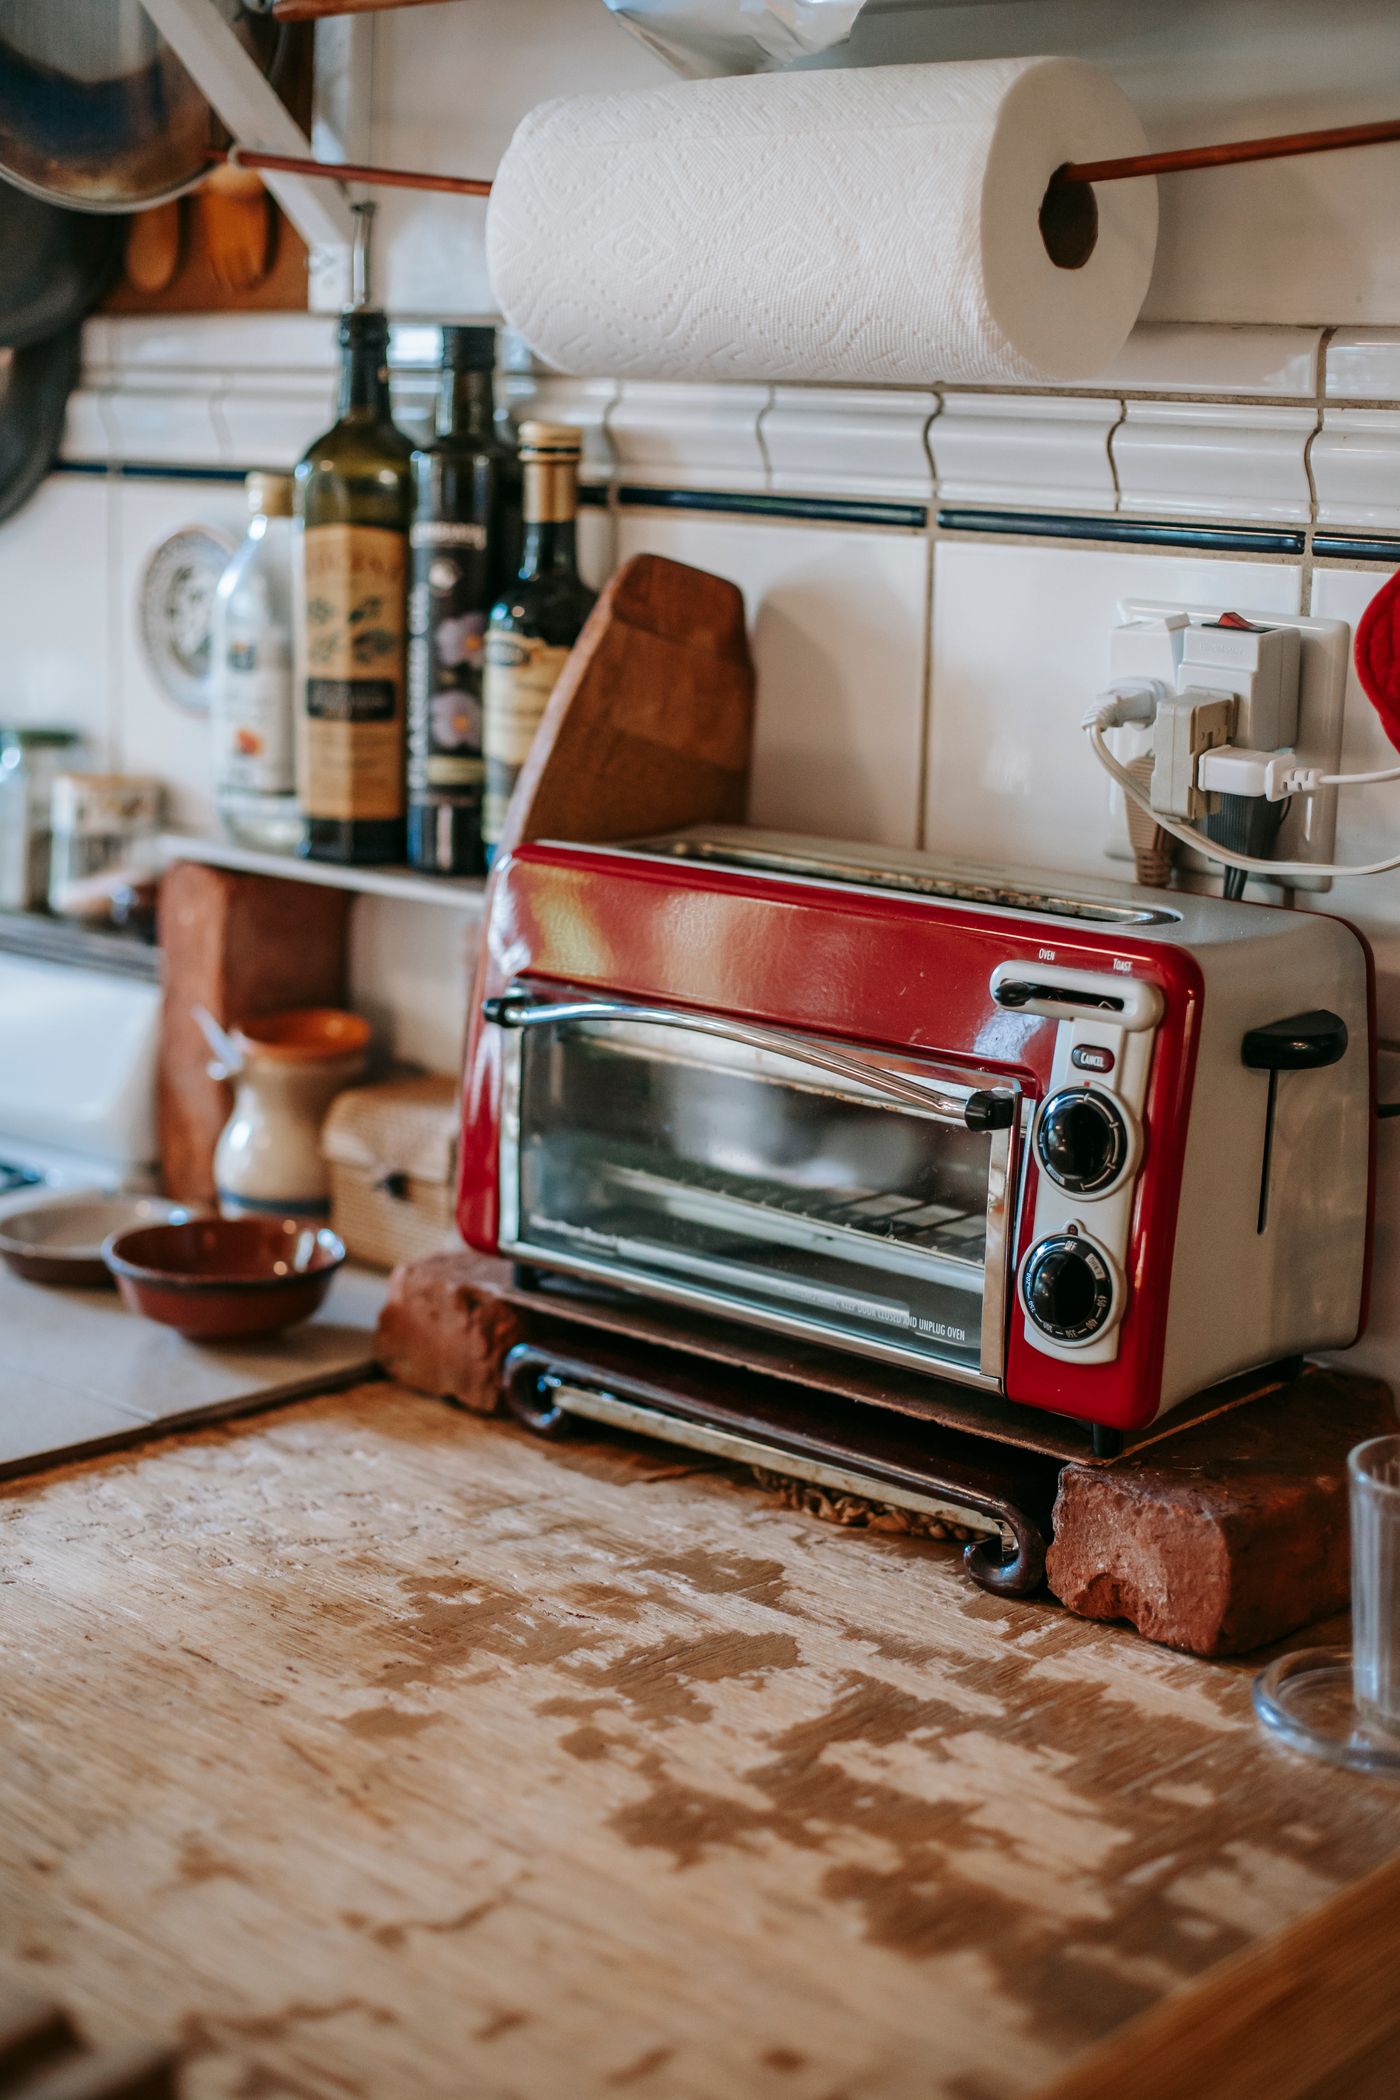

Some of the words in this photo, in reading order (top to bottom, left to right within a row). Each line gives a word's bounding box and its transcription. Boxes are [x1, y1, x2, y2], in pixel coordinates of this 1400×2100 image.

[1038, 948, 1056, 961] OVEN
[1113, 958, 1132, 971] TOAST
[1080, 1052, 1104, 1067] CANCEL
[1065, 1240, 1077, 1251] OFF
[877, 1308, 902, 1324] CLOSED
[903, 1314, 918, 1328] AND
[918, 1318, 946, 1336] UNPLUG
[947, 1326, 965, 1342] OVEN
